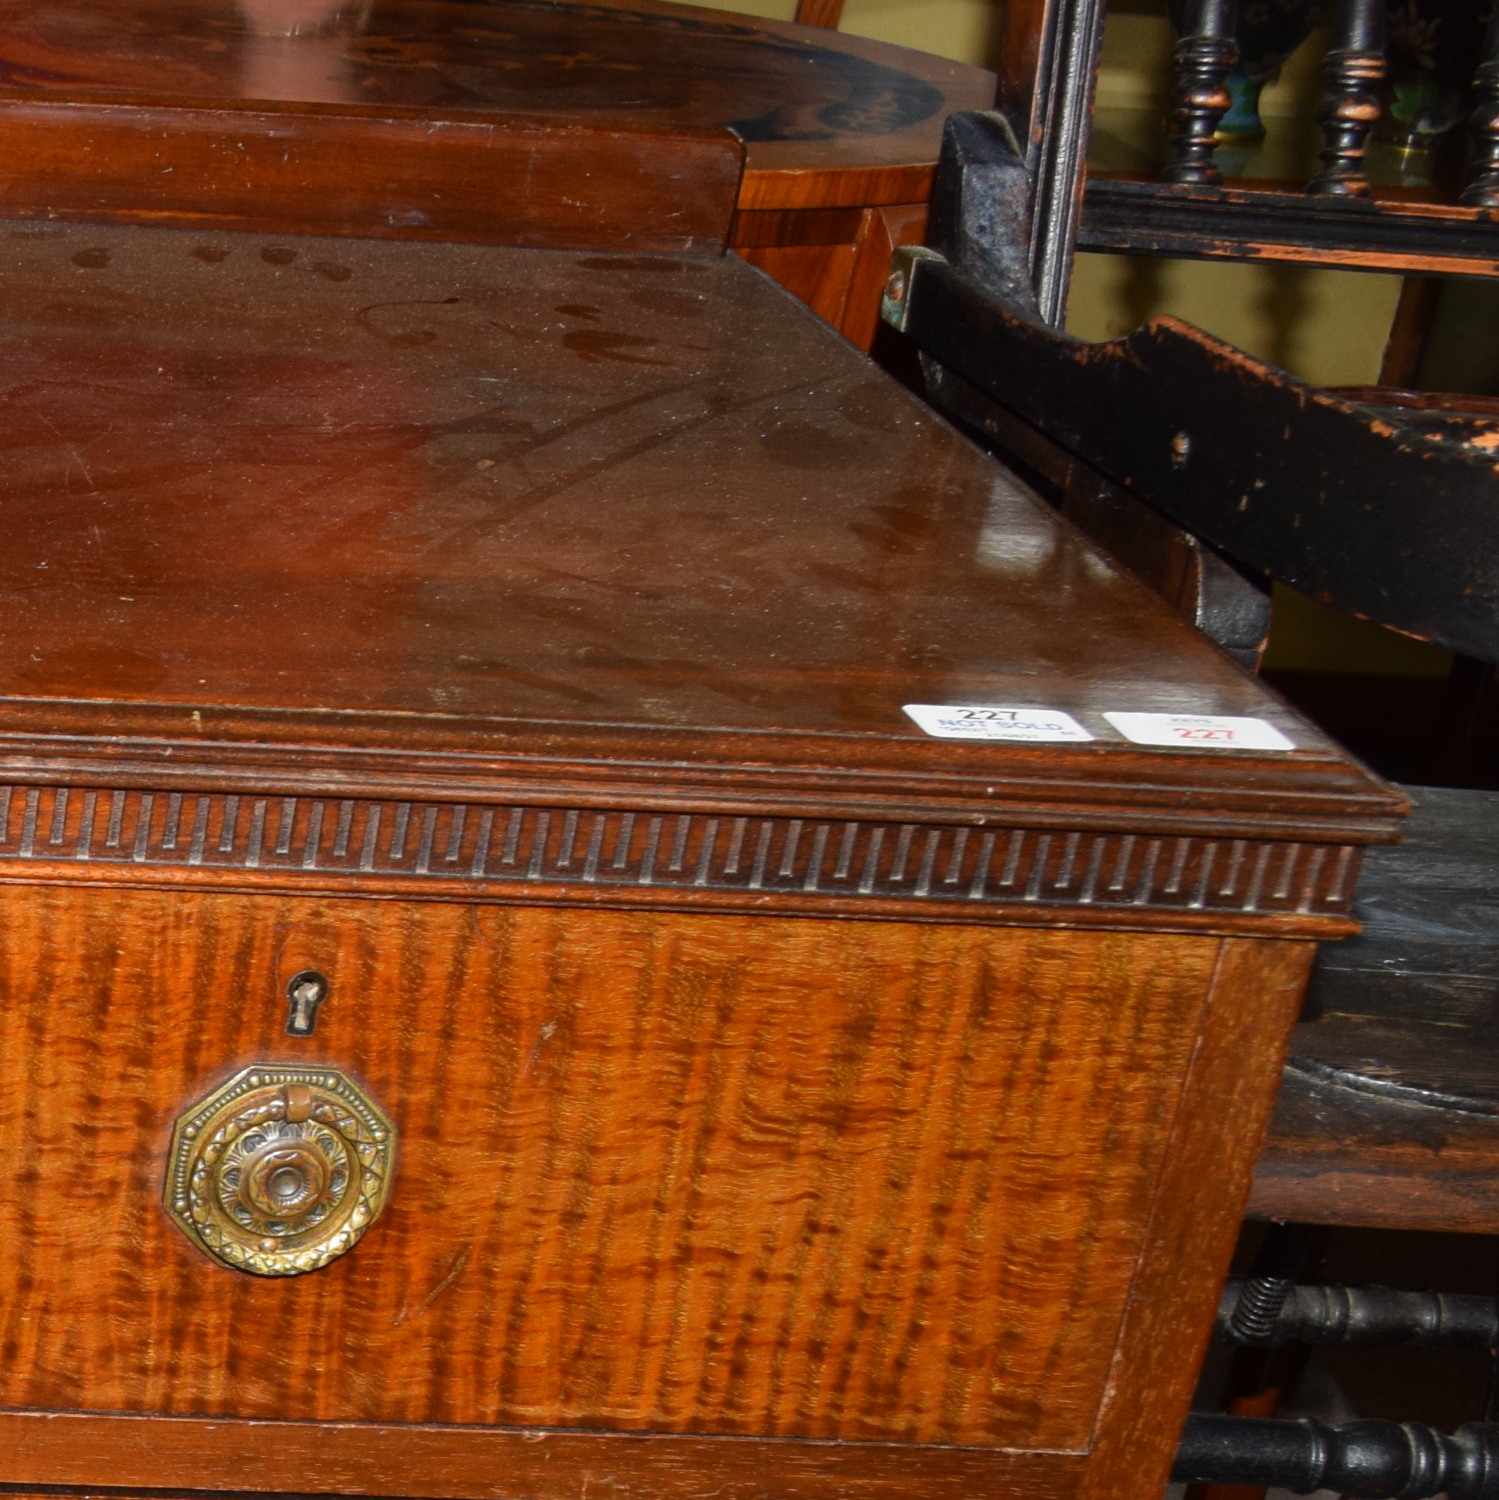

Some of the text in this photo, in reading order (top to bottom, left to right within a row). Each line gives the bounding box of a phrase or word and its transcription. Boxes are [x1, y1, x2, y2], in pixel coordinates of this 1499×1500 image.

[956, 709, 1018, 721] 227
[937, 719, 987, 728] NOT
[996, 721, 1063, 731] SOLD
[1173, 728, 1236, 741] 227
